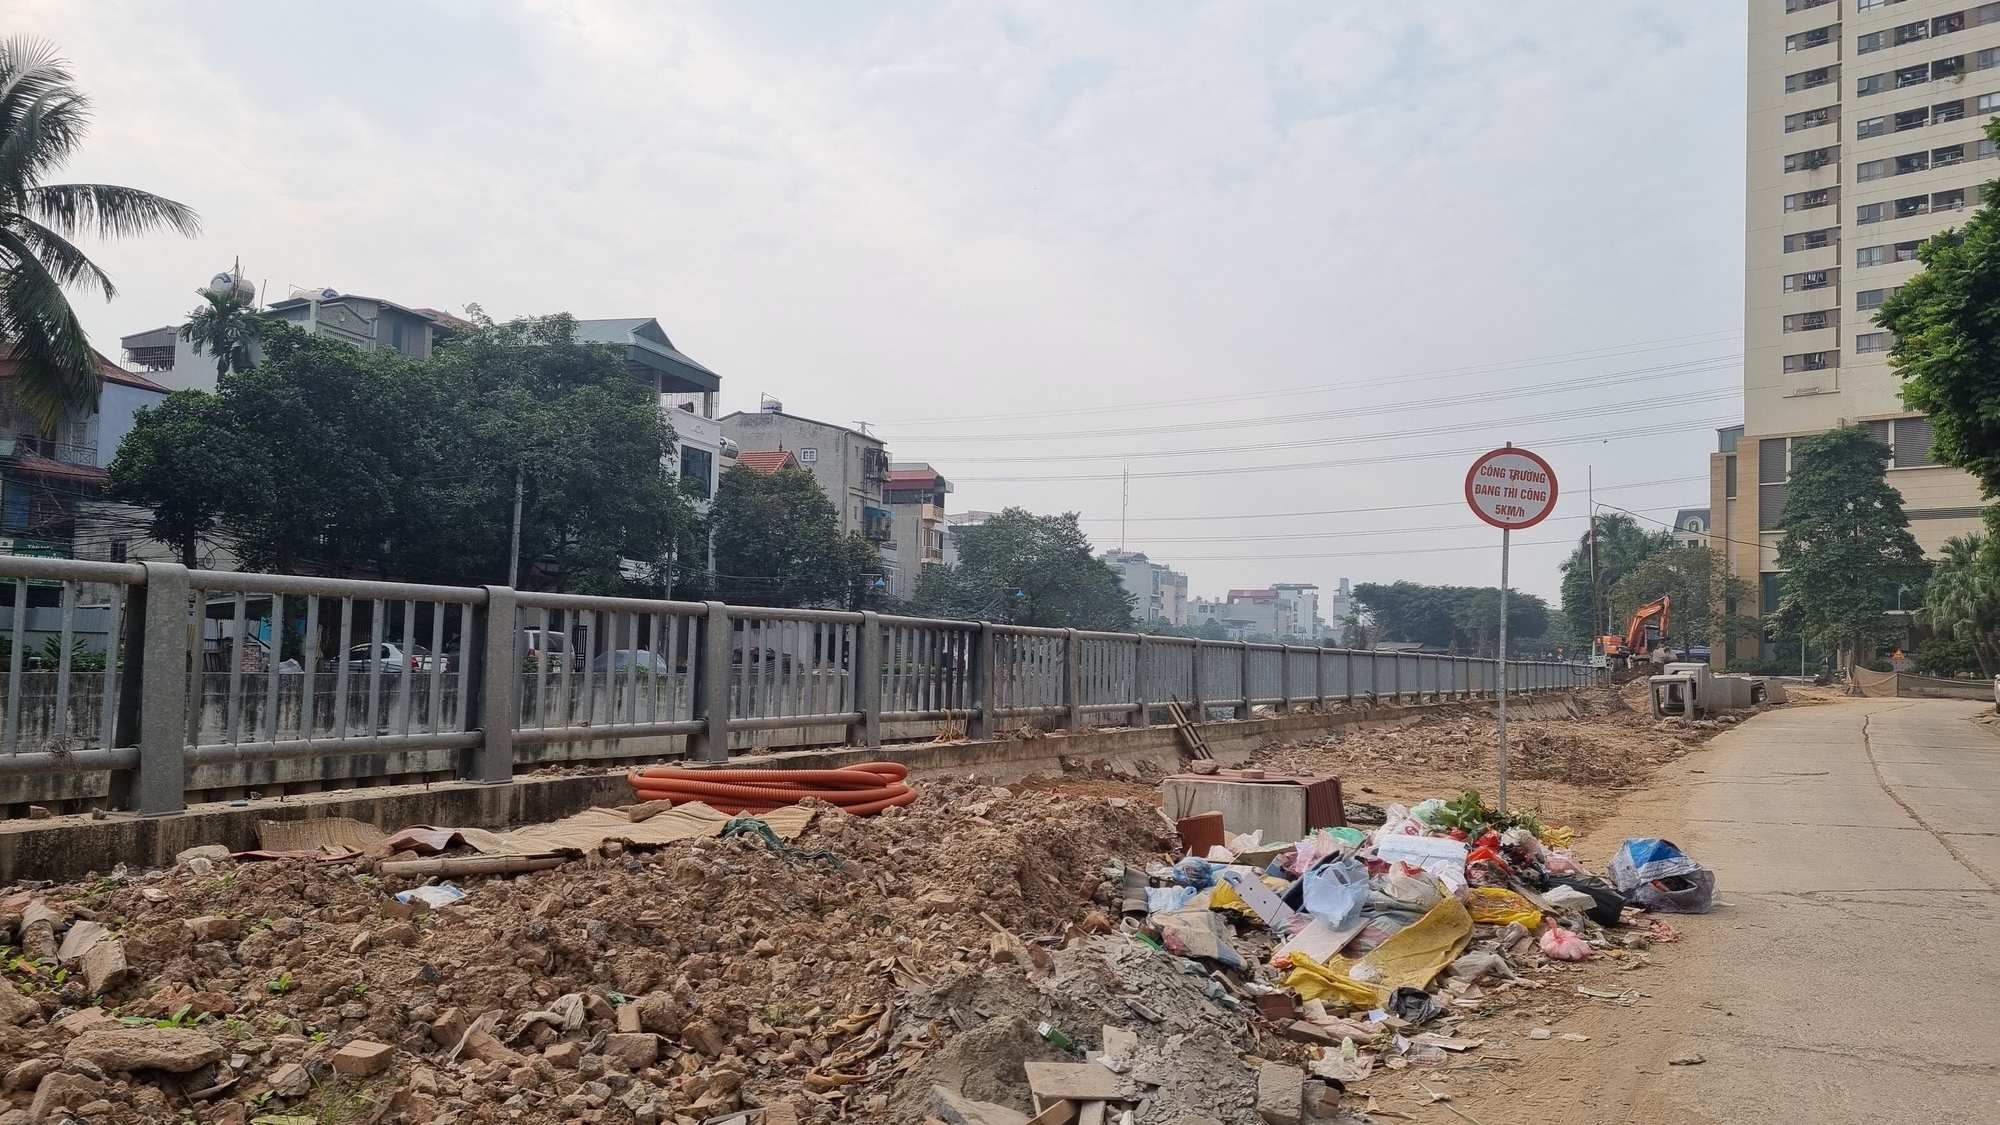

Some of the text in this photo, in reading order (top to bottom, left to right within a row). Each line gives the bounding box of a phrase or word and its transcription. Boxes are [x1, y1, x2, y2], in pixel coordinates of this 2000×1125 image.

[1480, 465, 1546, 483] CÔNG TRƯỜNG
[1475, 484, 1547, 502] ĐANG THI CÔNG
[1495, 504, 1525, 517] 5KM/h
